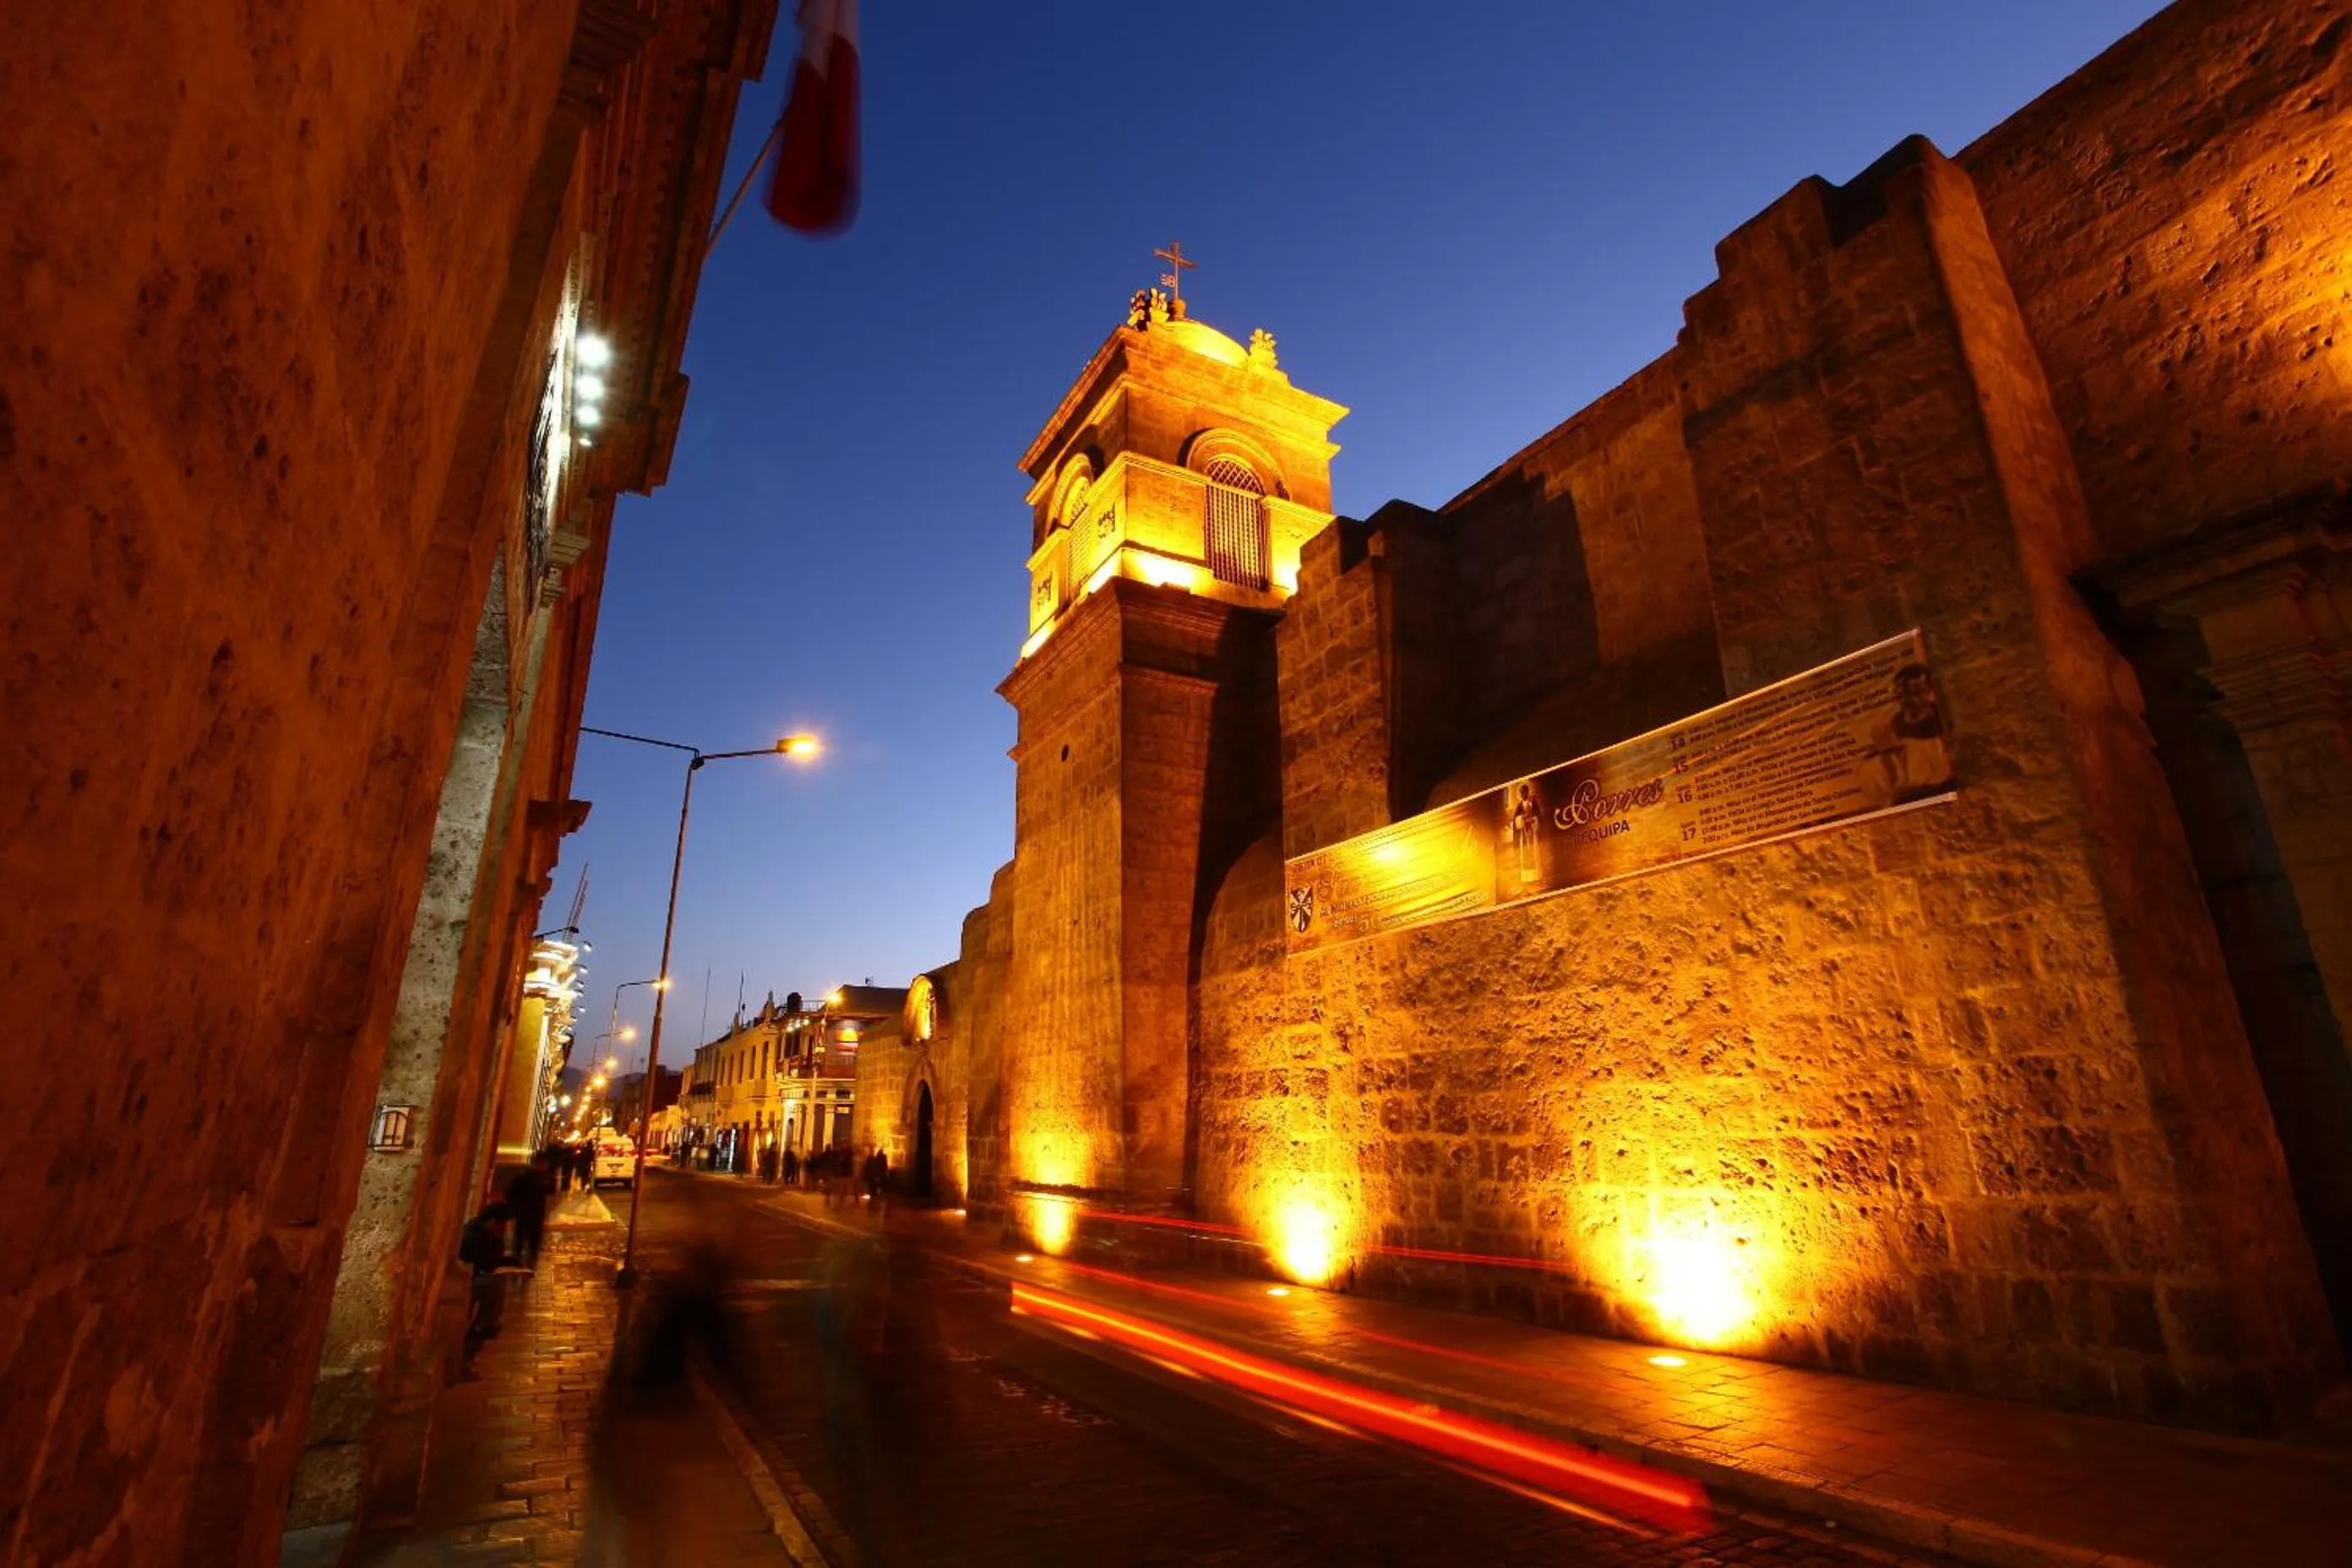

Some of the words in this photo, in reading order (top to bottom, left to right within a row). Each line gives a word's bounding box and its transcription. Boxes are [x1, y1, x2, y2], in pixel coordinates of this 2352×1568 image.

[1675, 762, 1689, 775] 15
[1554, 778, 1663, 830] Porres
[1678, 790, 1692, 804] 16
[1682, 827, 1696, 841] 17
